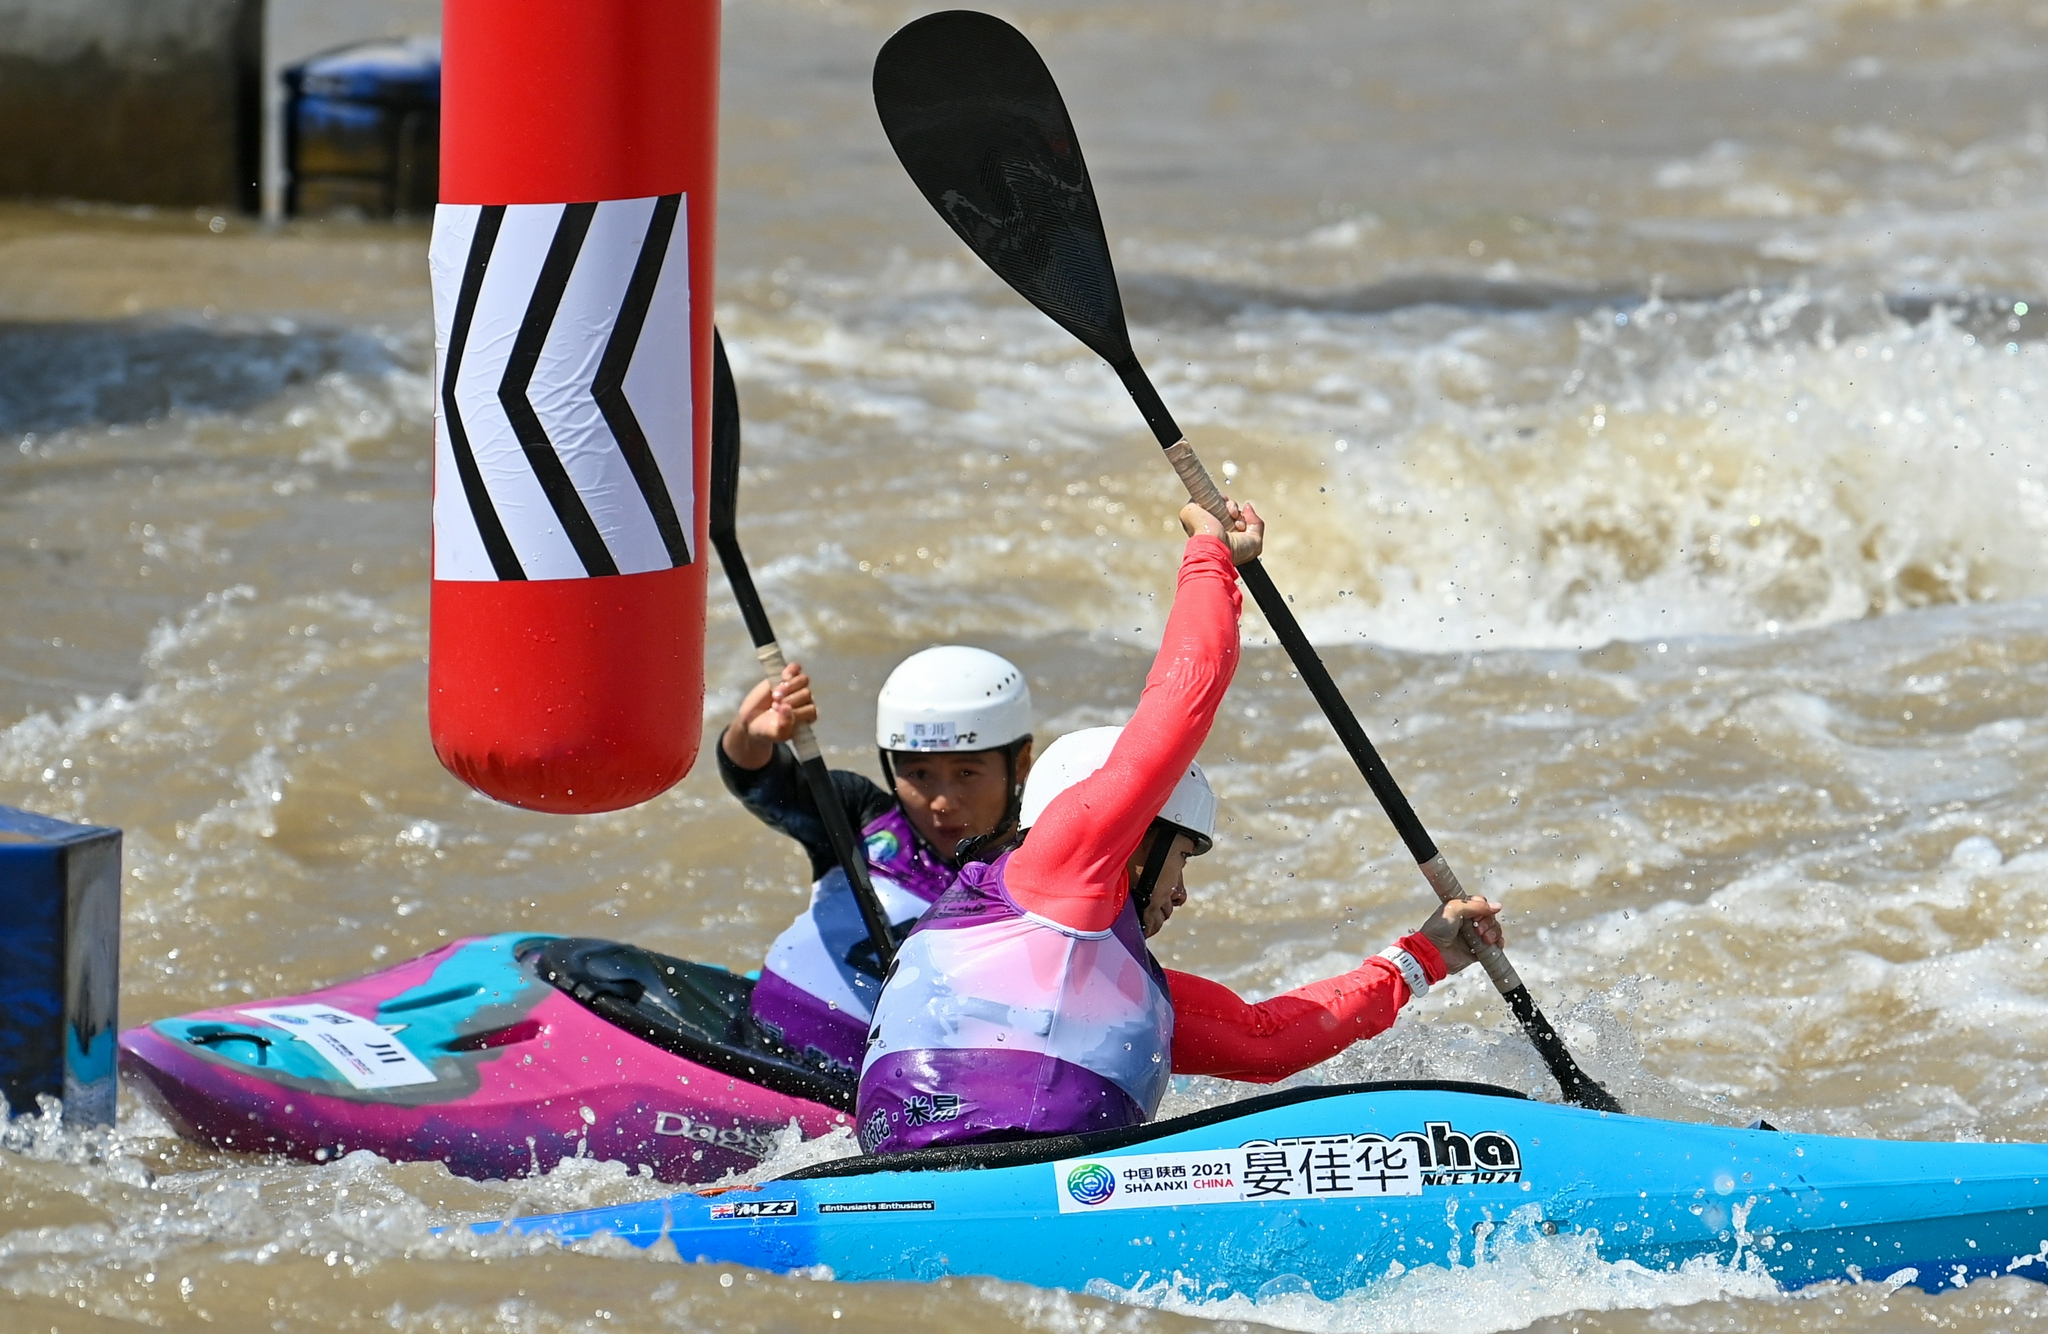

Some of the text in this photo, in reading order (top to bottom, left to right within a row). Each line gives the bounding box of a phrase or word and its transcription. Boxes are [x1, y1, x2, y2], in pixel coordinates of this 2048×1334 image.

[1191, 1162, 1232, 1177] 2021
[1242, 1144, 1410, 1198] 晏佳华
[1124, 1178, 1235, 1194] SHAANXI CHINA
[1421, 1171, 1522, 1186] NCE 1971
